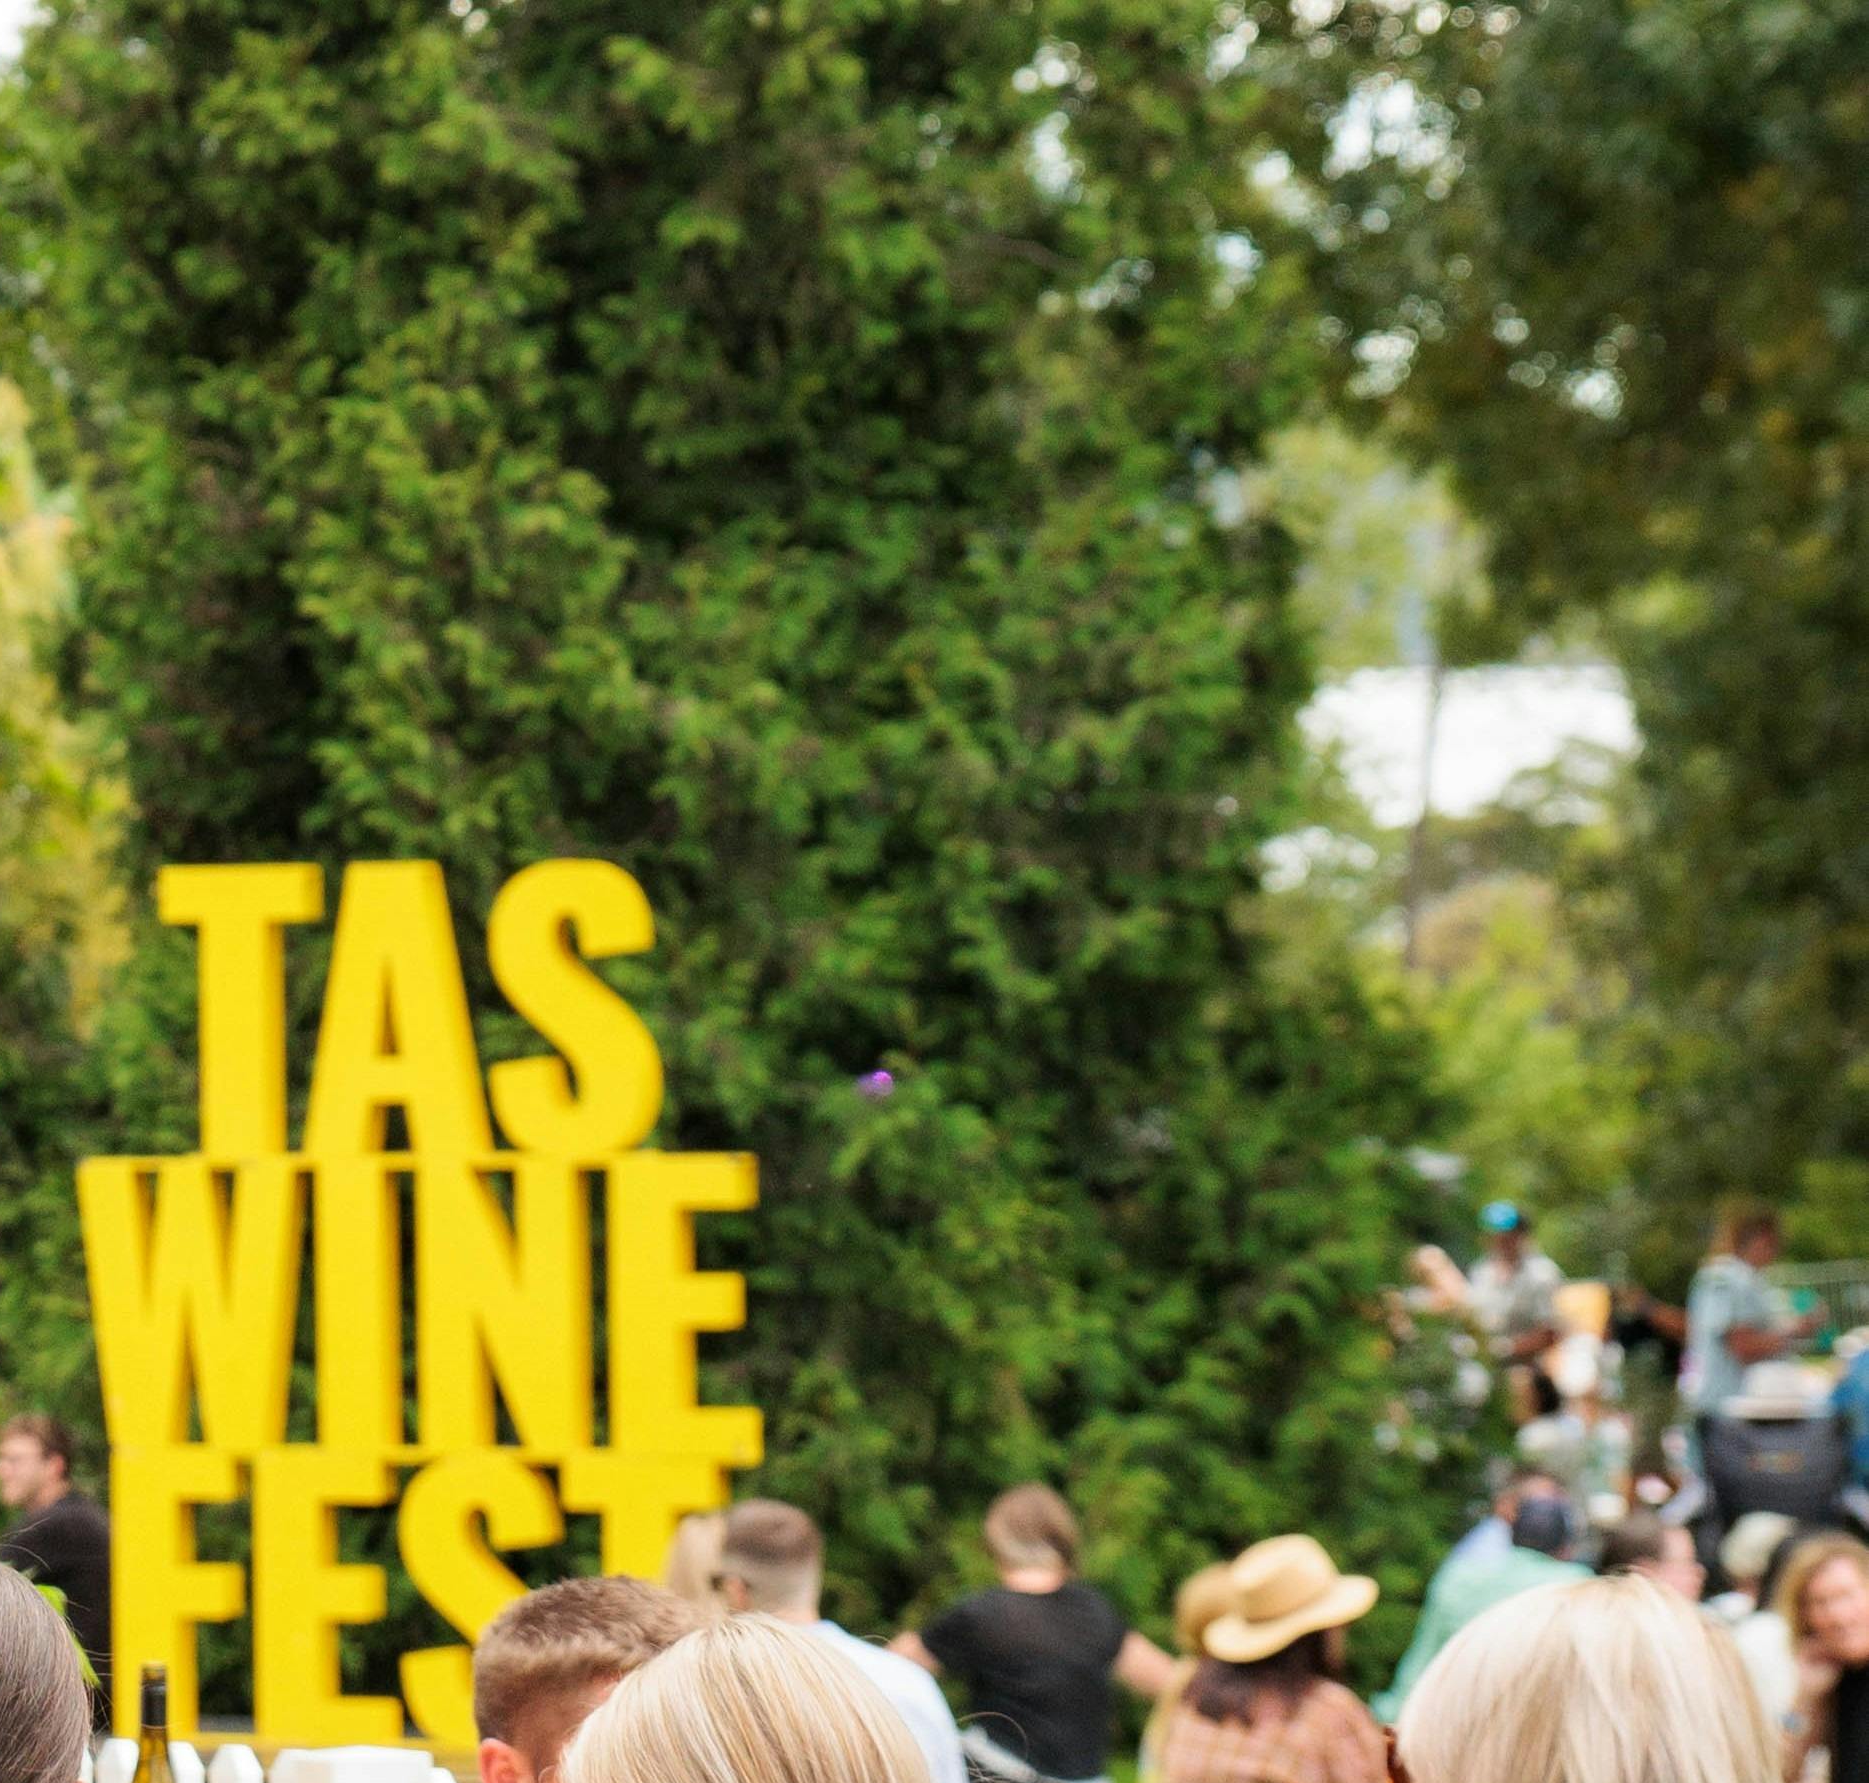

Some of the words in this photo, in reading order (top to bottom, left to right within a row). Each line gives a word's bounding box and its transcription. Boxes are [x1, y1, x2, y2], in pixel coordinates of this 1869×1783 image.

[157, 857, 664, 1153] TAS
[77, 1151, 764, 1466] WINE
[110, 1446, 729, 1744] FEST
